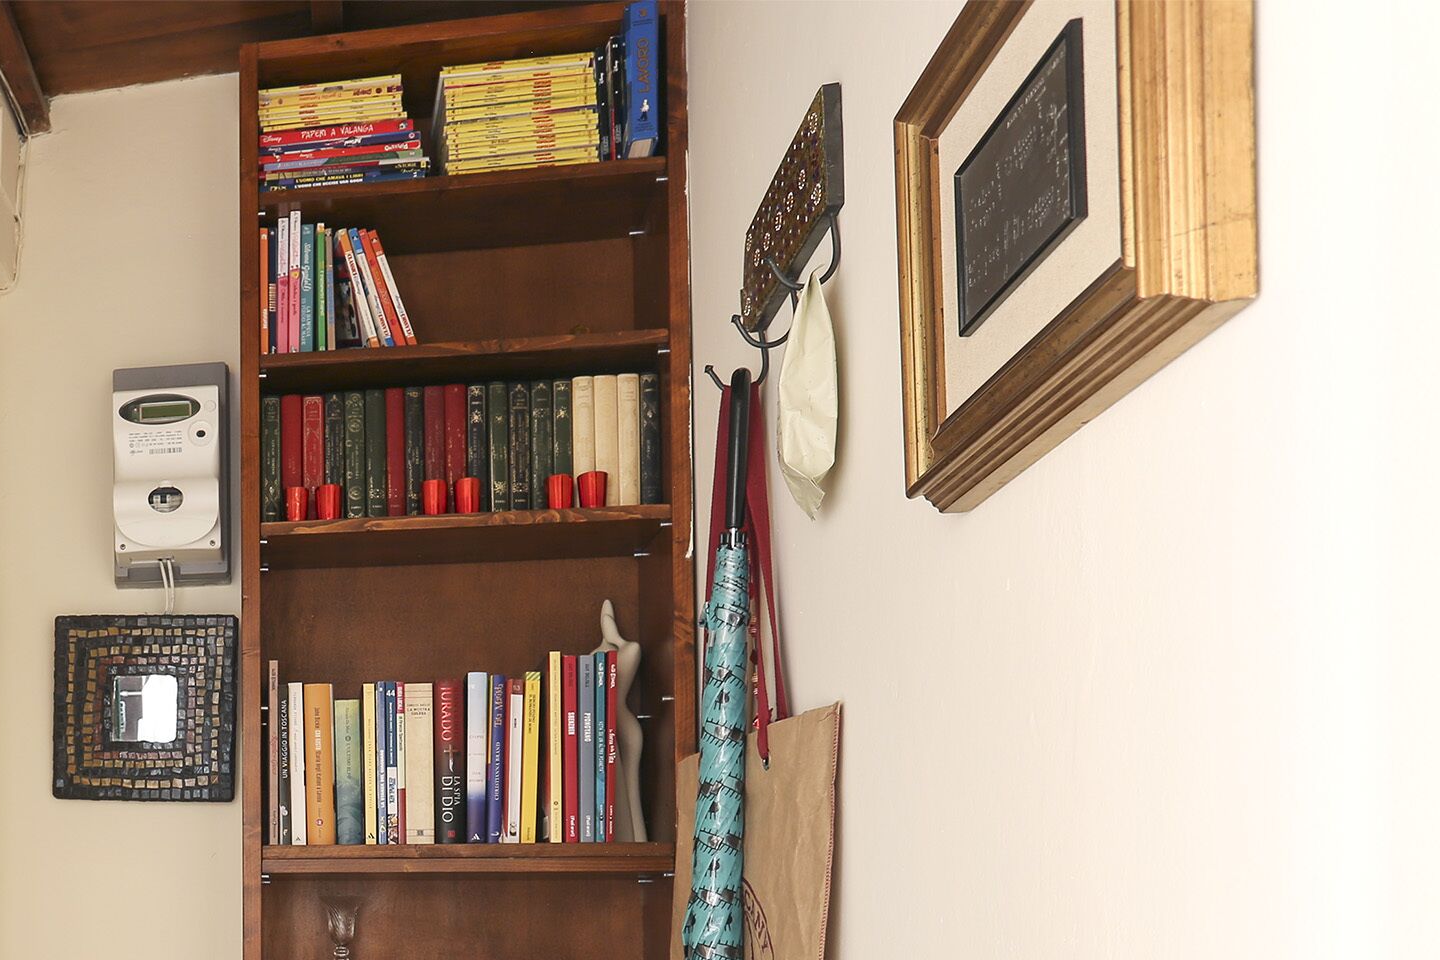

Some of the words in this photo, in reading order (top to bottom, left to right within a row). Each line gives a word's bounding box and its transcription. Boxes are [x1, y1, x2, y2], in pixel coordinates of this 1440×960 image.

[637, 37, 650, 94] LAVORO
[330, 128, 336, 137] A
[340, 123, 374, 135] VALANGA
[440, 686, 452, 741] JURADO
[281, 731, 287, 739] IN
[282, 768, 288, 779] UN
[442, 776, 453, 790] DI
[454, 776, 460, 786] LA
[442, 796, 453, 823] DIO
